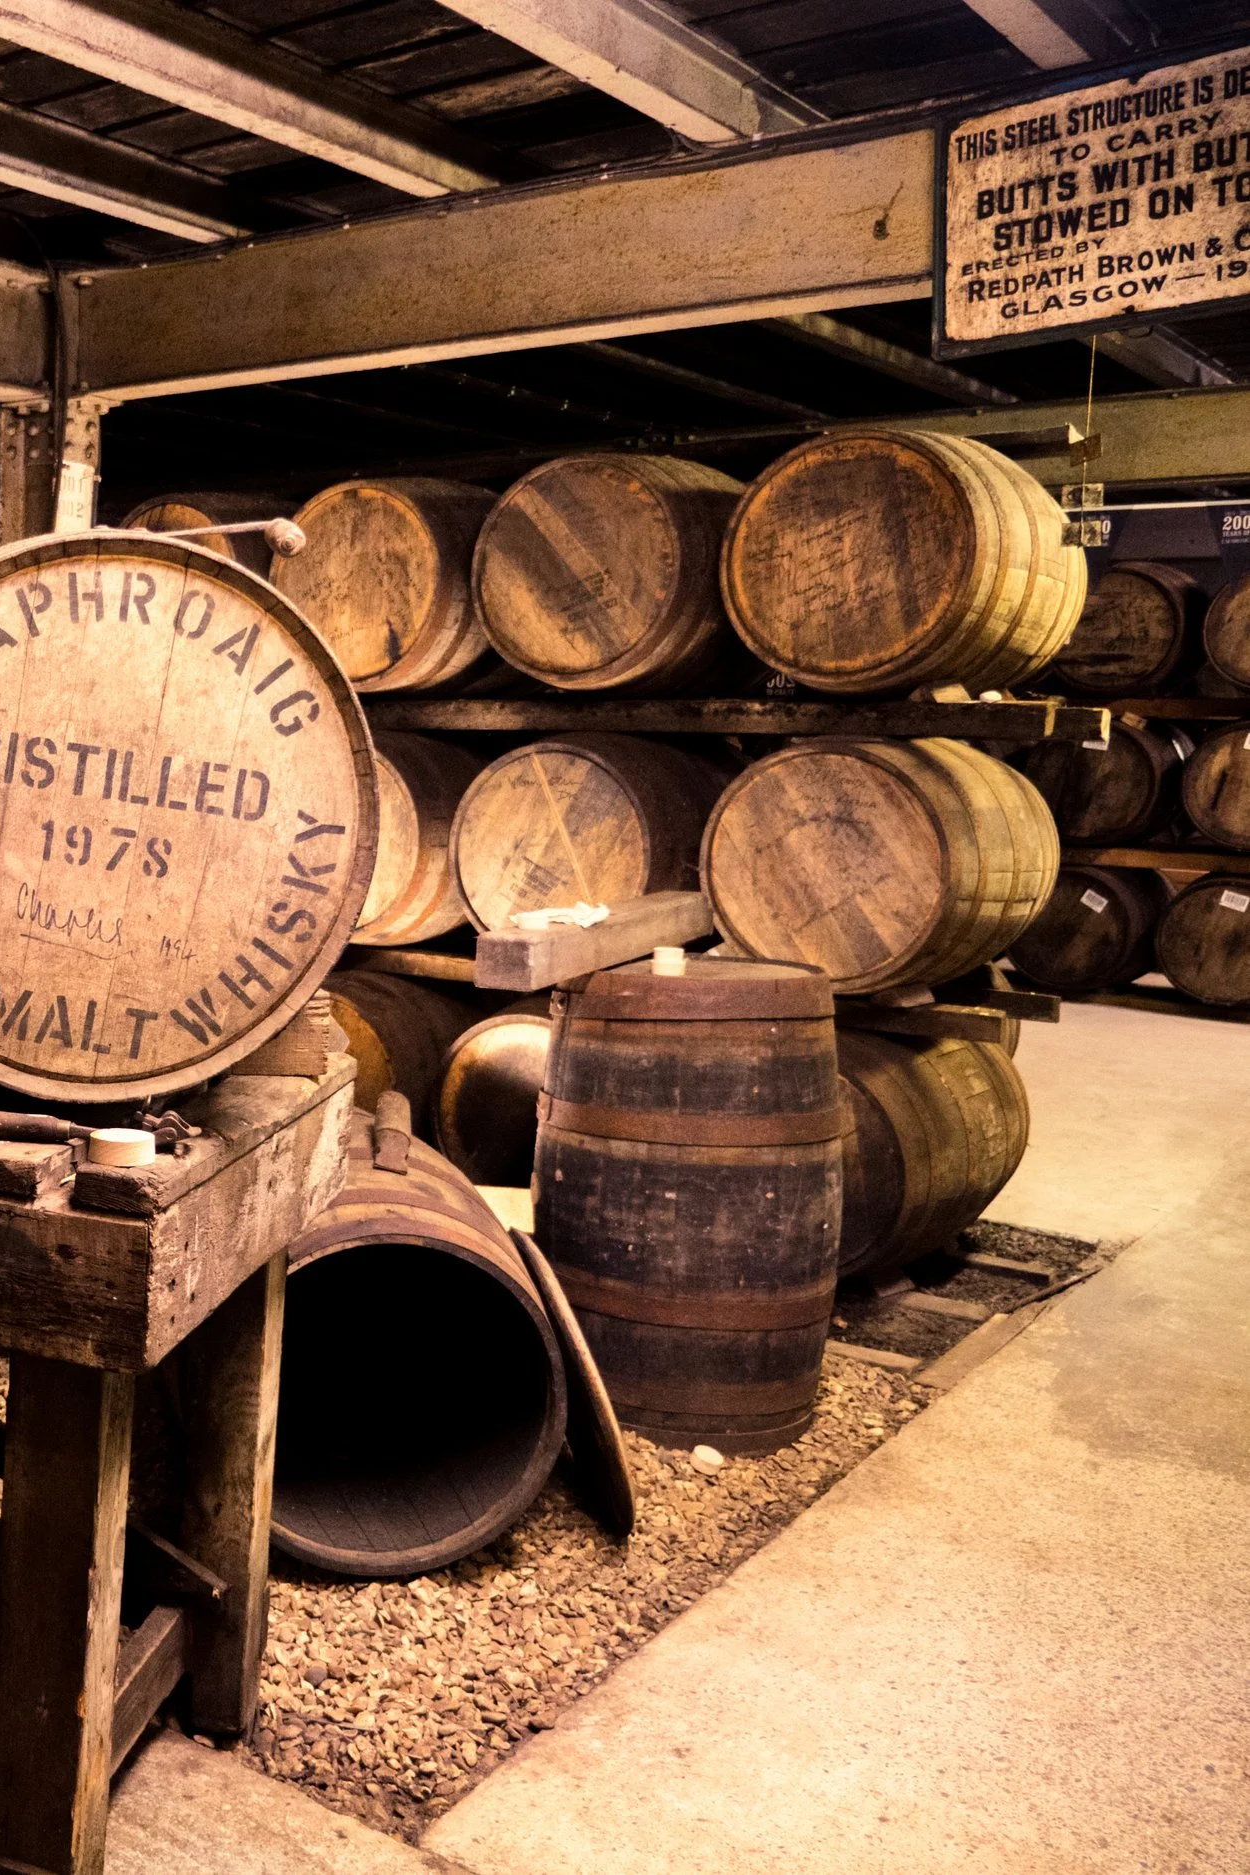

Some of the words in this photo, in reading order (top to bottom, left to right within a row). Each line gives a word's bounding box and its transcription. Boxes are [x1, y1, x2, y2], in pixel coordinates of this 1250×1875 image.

[955, 128, 997, 164] THIS
[1004, 114, 1061, 152] STEEL
[1067, 87, 1186, 137] STRUCTURE
[1193, 75, 1213, 107] IS
[1224, 65, 1250, 99] DE
[1050, 143, 1090, 166] TO
[1106, 109, 1222, 152] CARRY
[976, 171, 1077, 220] BUTTS
[1092, 148, 1174, 194] WITH
[993, 198, 1131, 252] STOWED
[1148, 183, 1194, 220] ON
[1211, 171, 1250, 207] TO
[961, 246, 1064, 277] ERECTED
[1075, 237, 1106, 254] BY
[967, 264, 1084, 303] REDPATH
[1098, 242, 1194, 278] BROWN
[1205, 238, 1223, 258] &
[1000, 274, 1168, 320] GLASGOW
[1217, 261, 1248, 281] 19
[1222, 515, 1250, 531] 200
[41, 819, 173, 878] 1978
[168, 809, 347, 1047] WHISKY
